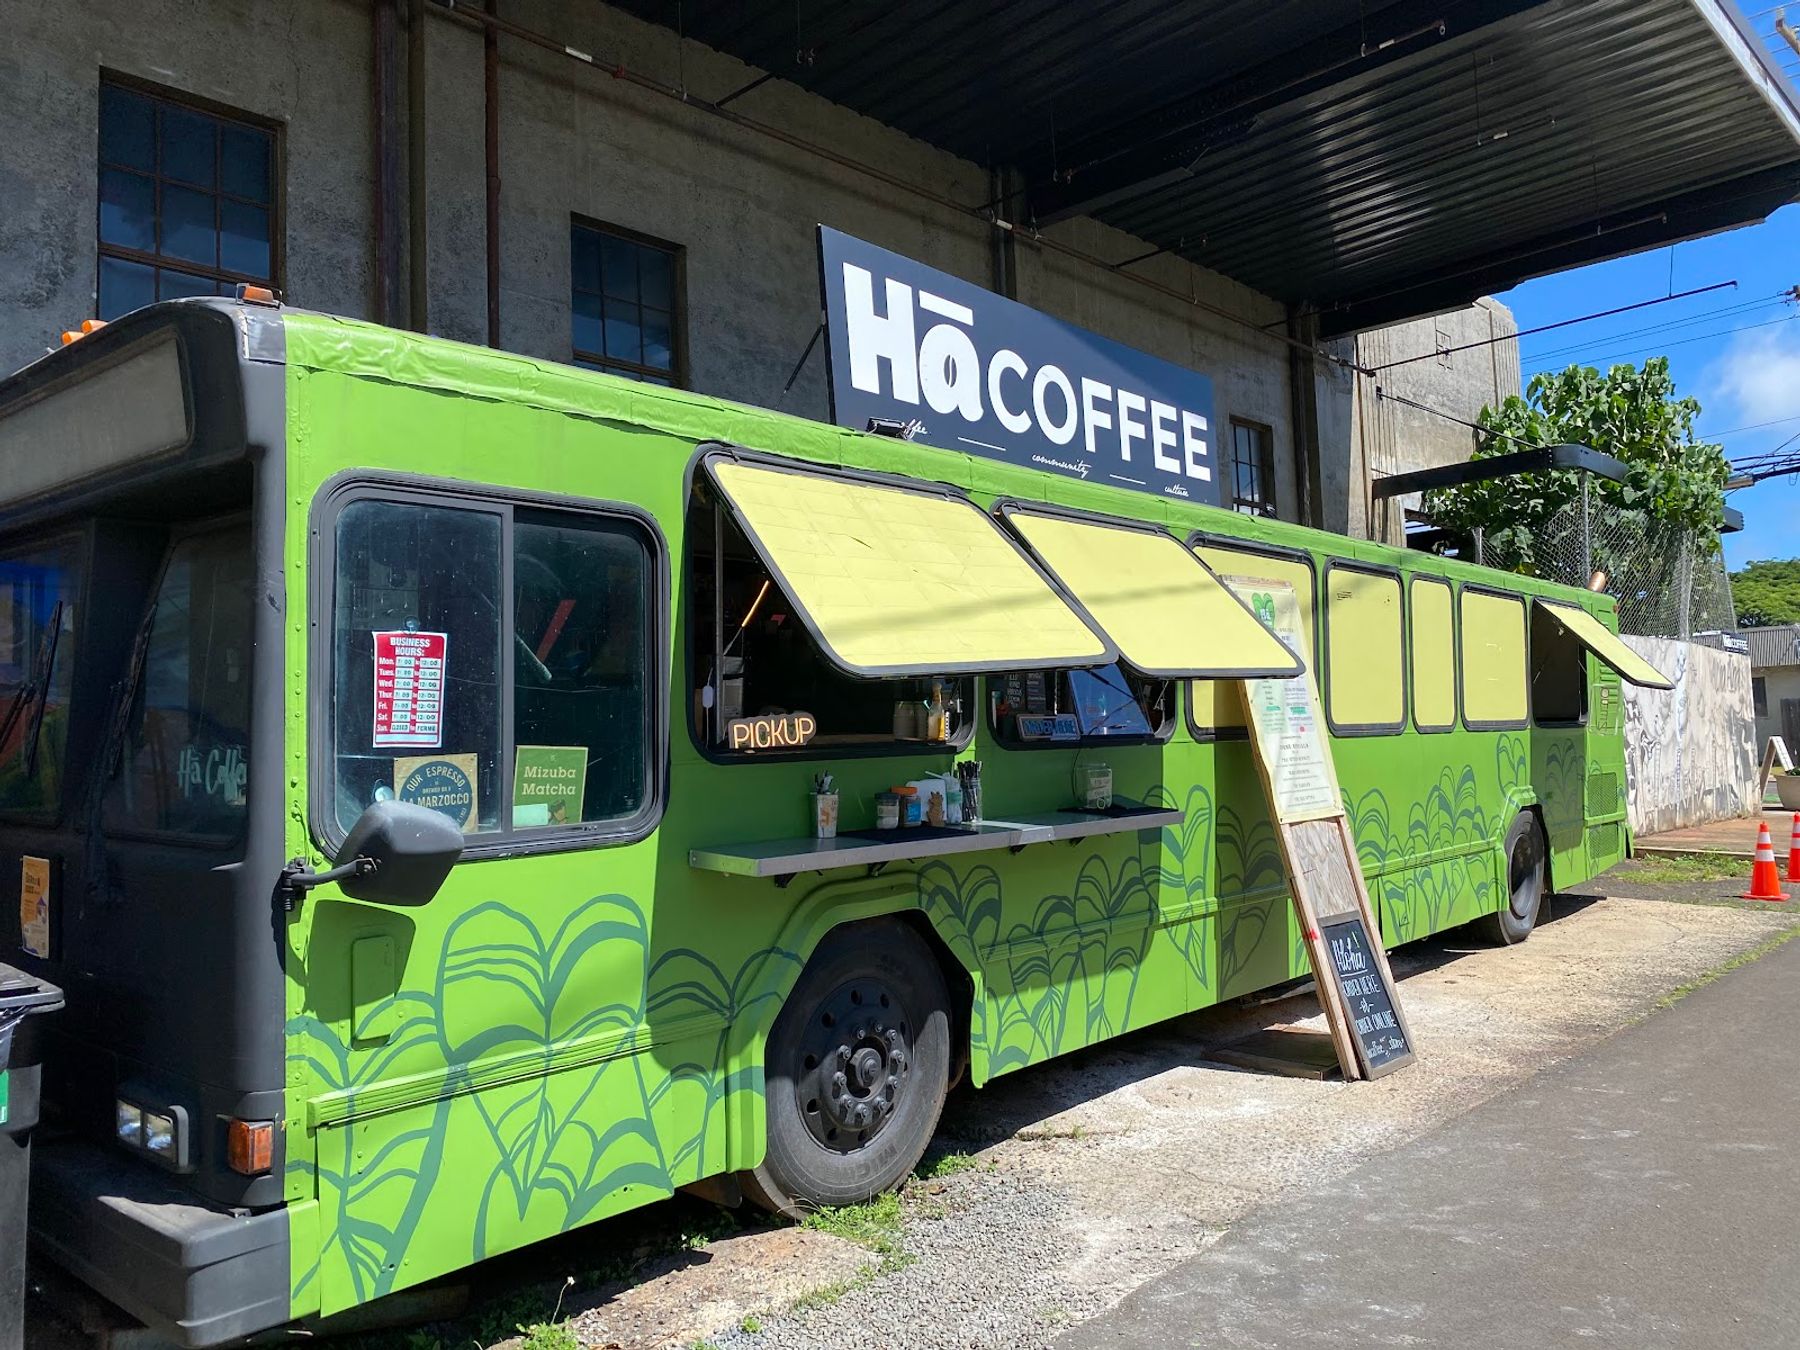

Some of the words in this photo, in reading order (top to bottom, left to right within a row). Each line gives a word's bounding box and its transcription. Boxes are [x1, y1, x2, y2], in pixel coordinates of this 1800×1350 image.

[843, 262, 984, 422] Hā
[987, 349, 1212, 482] COFFEE
[1032, 453, 1093, 479] community
[1164, 484, 1189, 497] culture
[390, 637, 431, 648] BUSINESS
[395, 646, 425, 656] HOURS:
[379, 657, 394, 665] Mon.
[733, 717, 814, 749] PICKUP
[406, 774, 423, 792] OUR
[426, 766, 466, 788] ESPRESSO
[523, 766, 576, 778] Mizuba
[522, 783, 576, 795] Matcha
[417, 792, 469, 808] MARZOCCO
